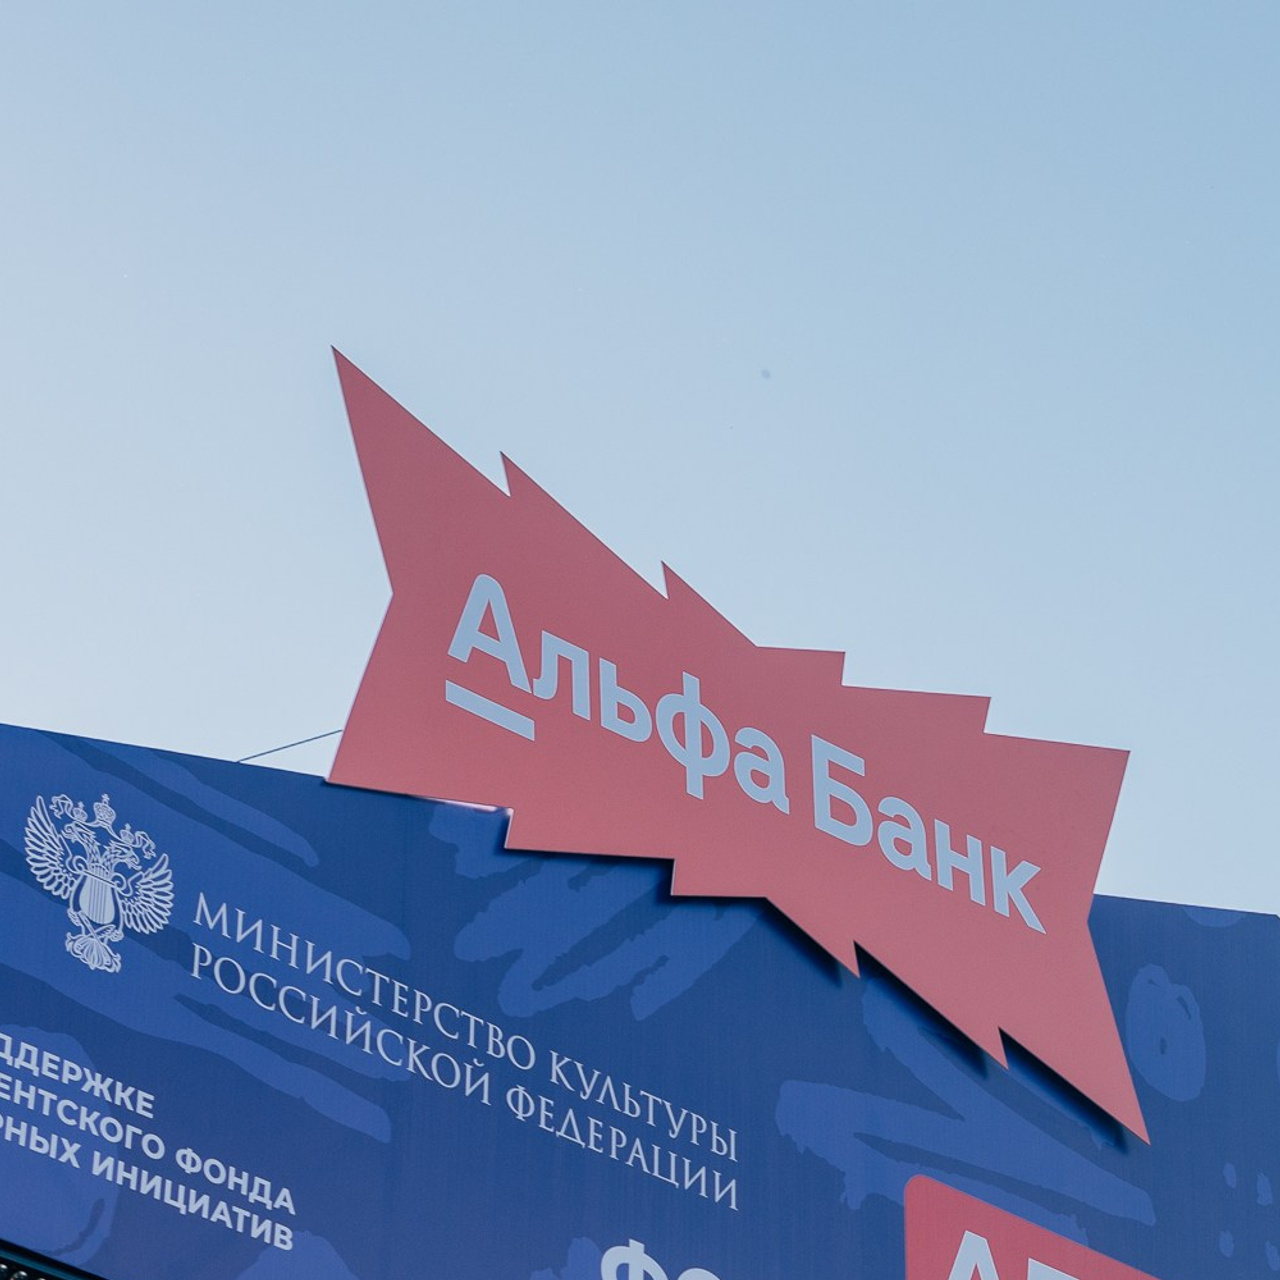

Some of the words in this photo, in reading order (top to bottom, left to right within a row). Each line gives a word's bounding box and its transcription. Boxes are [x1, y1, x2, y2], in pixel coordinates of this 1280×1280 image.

[448, 574, 789, 814] Альфа
[811, 735, 1046, 934] Банк
[190, 943, 492, 1105] РОССИЙСКОЙ
[506, 1084, 738, 1211] ФЕДЕРАЦИИ
[196, 892, 536, 1070] МИНИСТЕРСТВО
[550, 1051, 738, 1162] КУЛЬТУРЫ
[0, 1114, 81, 1168] НЫХ
[92, 1151, 293, 1250] ИНИЦИАТИВ
[175, 1147, 296, 1215] ФОНДА
